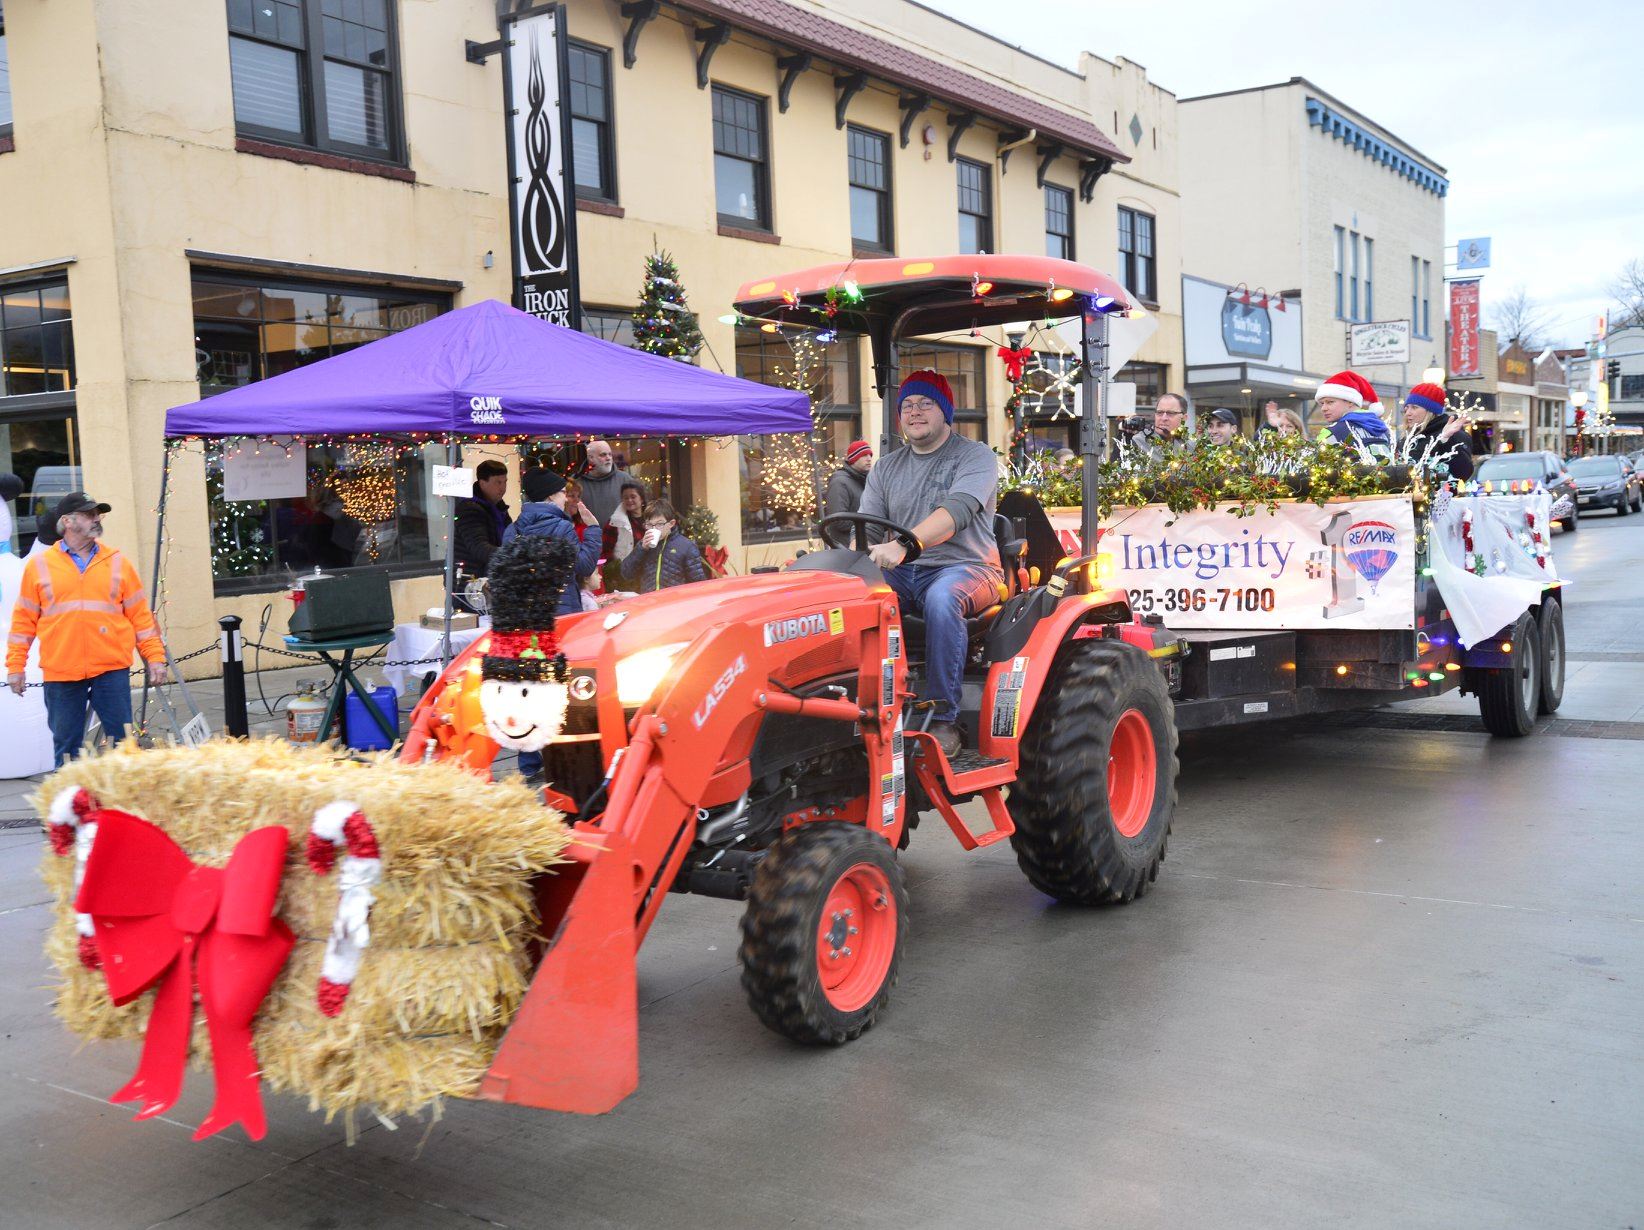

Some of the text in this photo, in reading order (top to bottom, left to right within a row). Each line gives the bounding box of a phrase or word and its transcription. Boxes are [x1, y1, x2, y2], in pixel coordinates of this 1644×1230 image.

[524, 284, 536, 292] THE
[524, 288, 569, 313] IRON
[470, 396, 503, 411] QUIK
[471, 410, 504, 420] SHADE
[1348, 529, 1397, 546] RE/MAX
[1121, 529, 1296, 580] Integrity
[1130, 588, 1275, 613] 25-396-7100
[763, 613, 828, 648] KUBOTA
[692, 653, 746, 729] LA534
